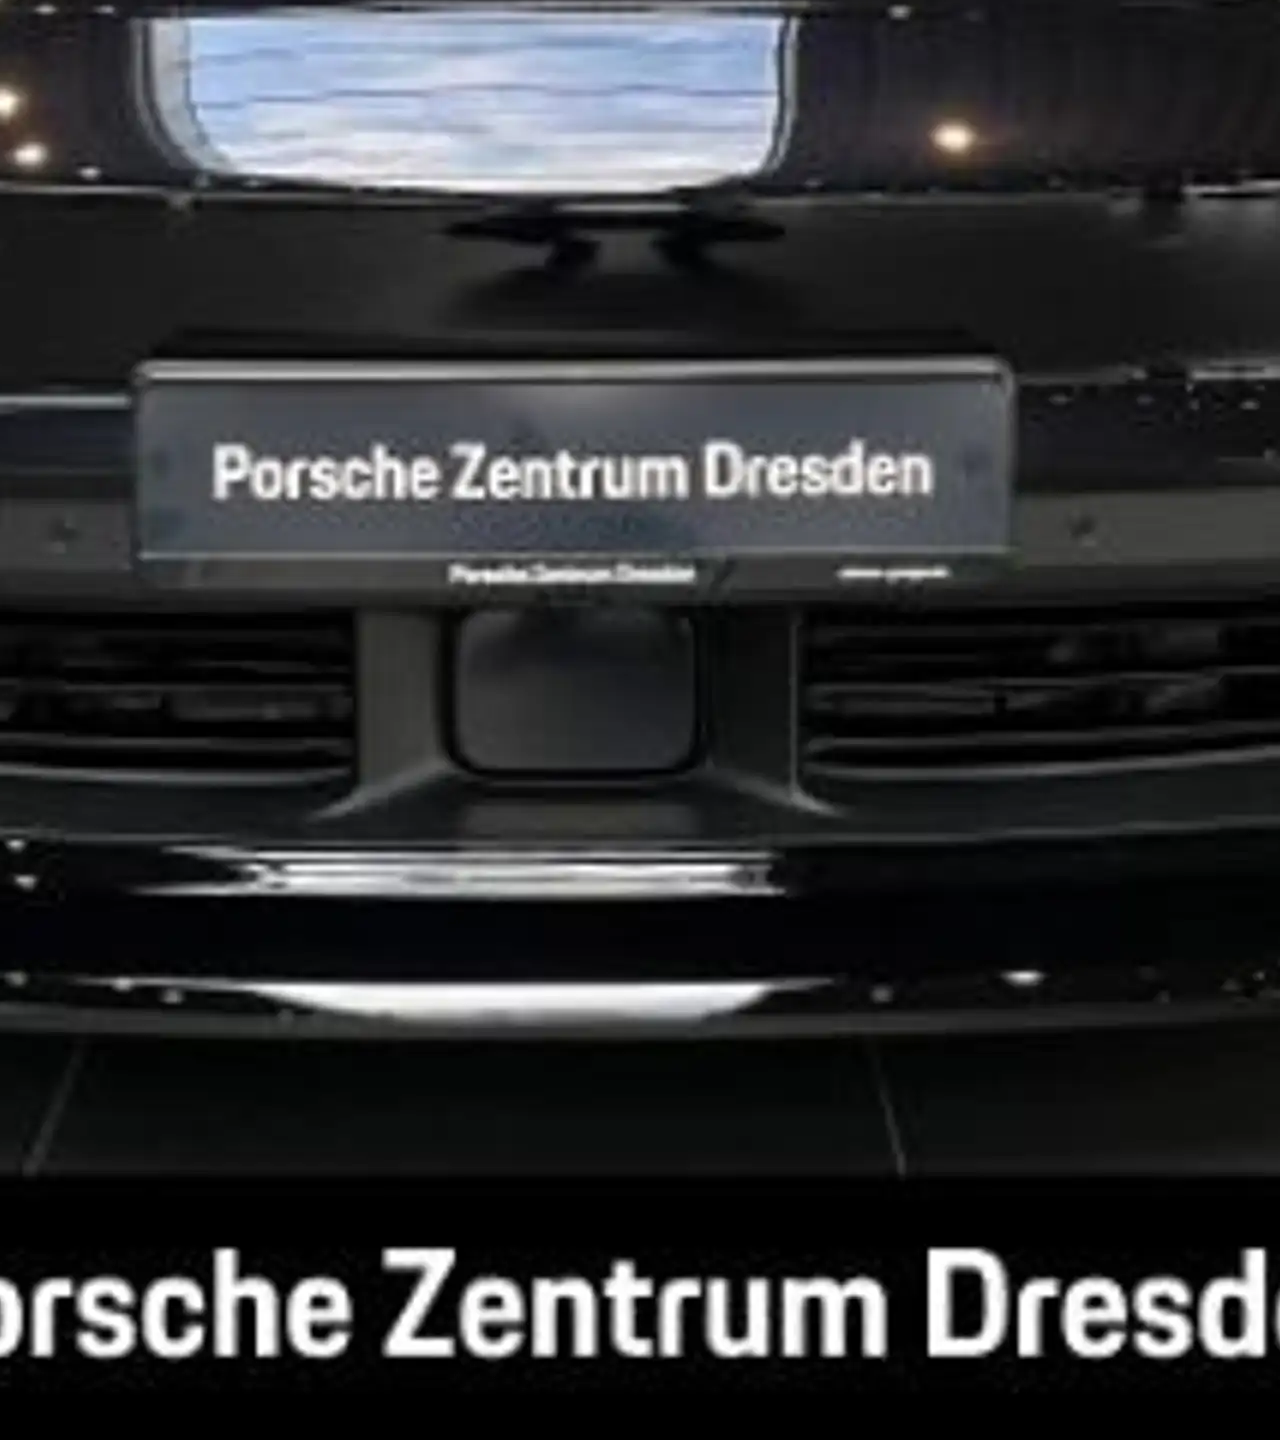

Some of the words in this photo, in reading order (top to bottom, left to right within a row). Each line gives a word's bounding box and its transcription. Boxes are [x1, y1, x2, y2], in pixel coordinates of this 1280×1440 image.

[211, 442, 442, 500] Porsche
[451, 441, 689, 500] Zentrum
[702, 438, 934, 498] Dresden
